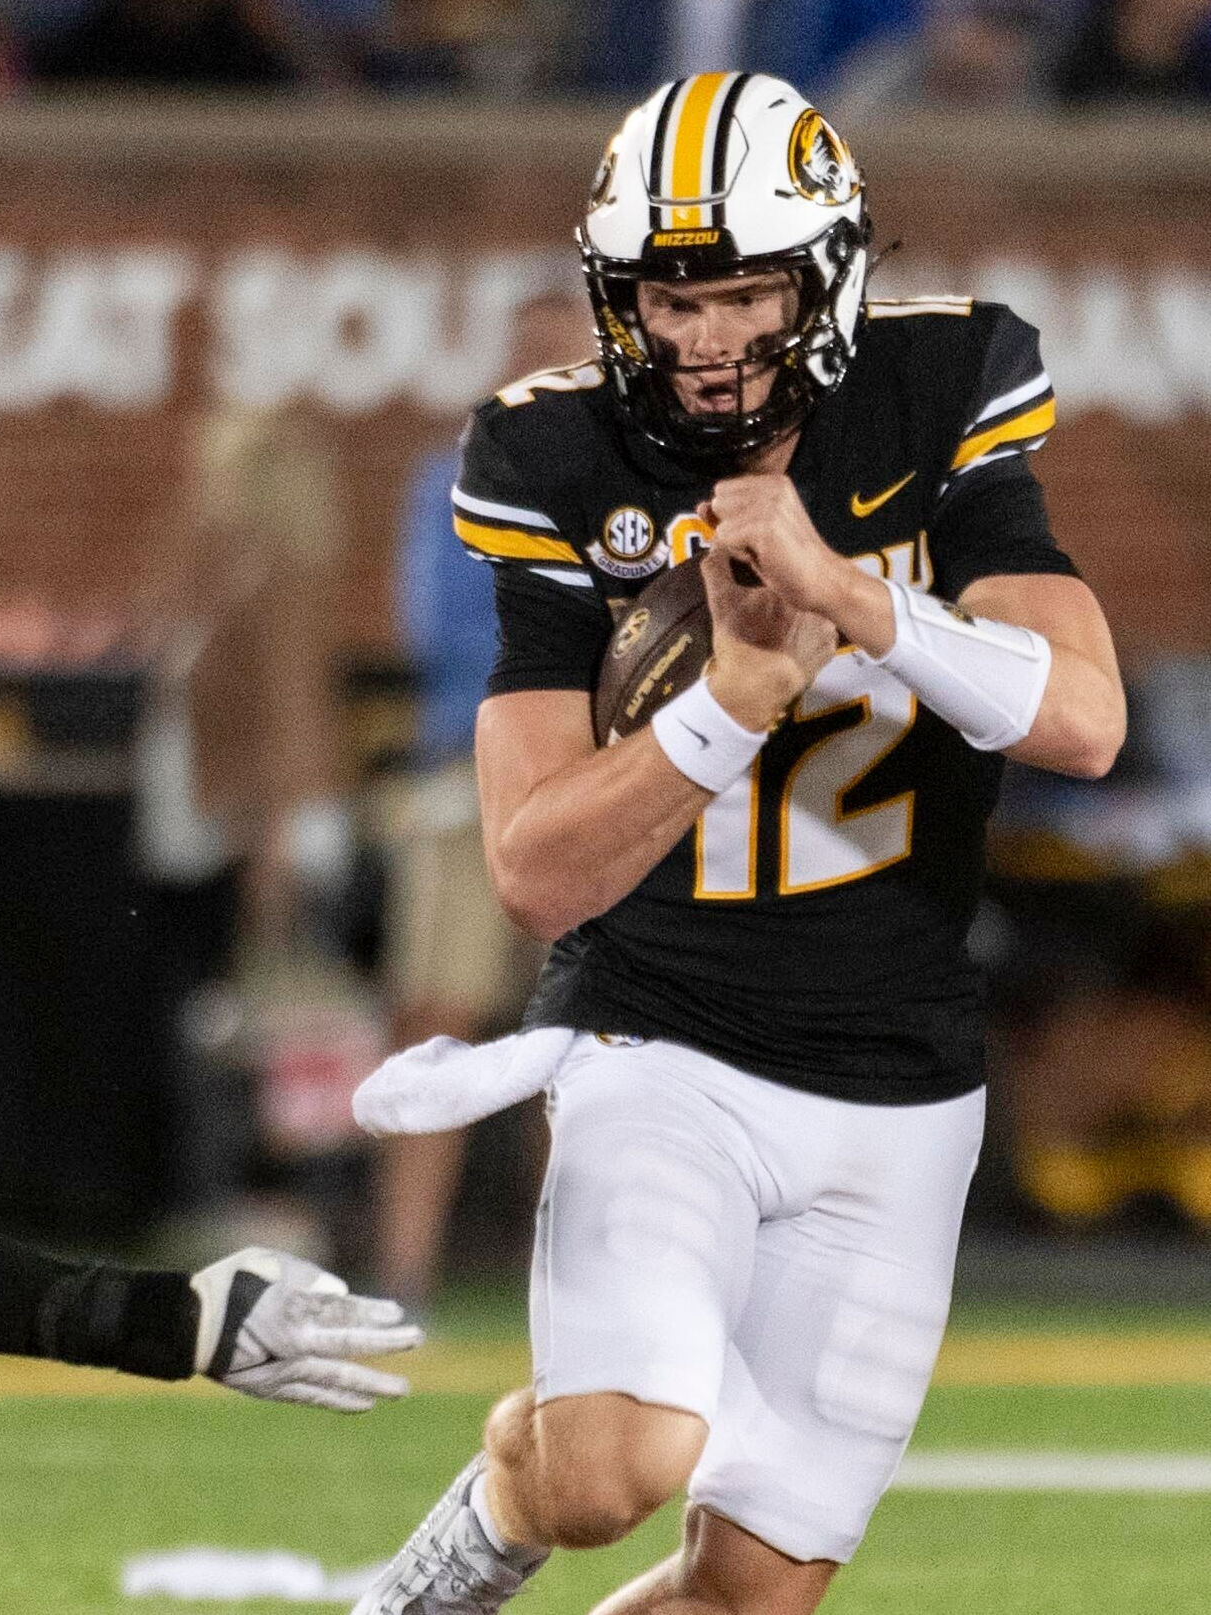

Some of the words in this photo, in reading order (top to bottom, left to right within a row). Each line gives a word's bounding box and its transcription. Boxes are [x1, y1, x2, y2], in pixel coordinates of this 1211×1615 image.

[653, 230, 720, 247] MIZZOU
[610, 511, 650, 554] SEC
[597, 555, 662, 578] GRADUATE
[693, 646, 918, 900] 12
